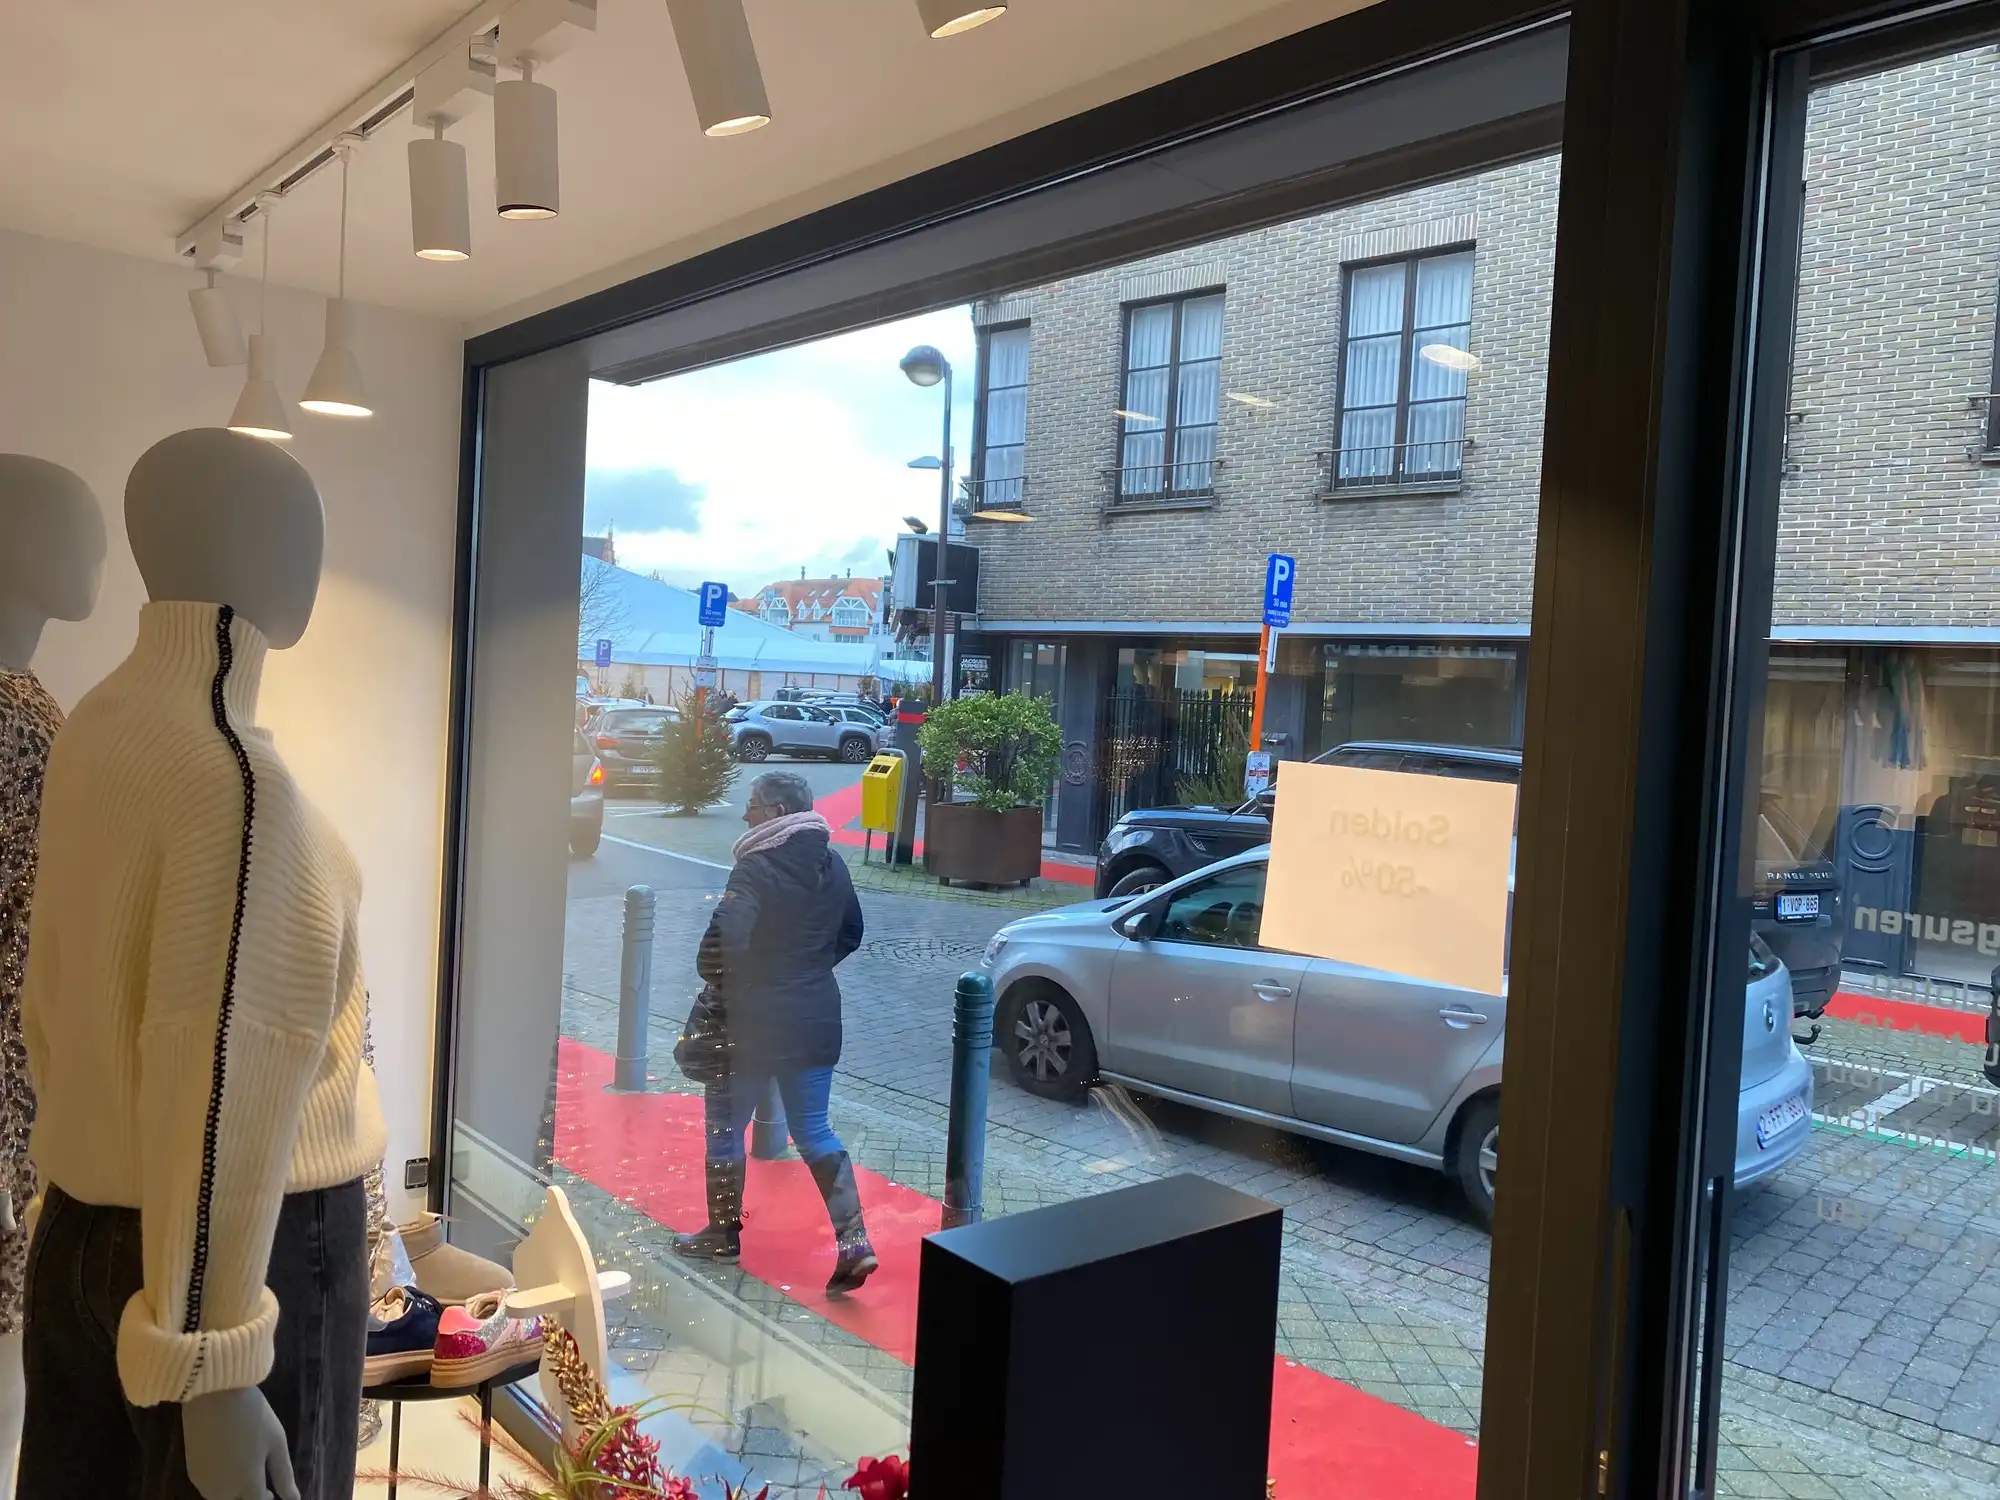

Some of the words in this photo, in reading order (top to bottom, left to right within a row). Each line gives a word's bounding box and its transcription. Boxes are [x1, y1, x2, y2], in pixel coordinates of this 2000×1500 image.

[1272, 558, 1290, 595] P
[706, 584, 722, 608] P
[1766, 872, 1805, 880] RANGE
